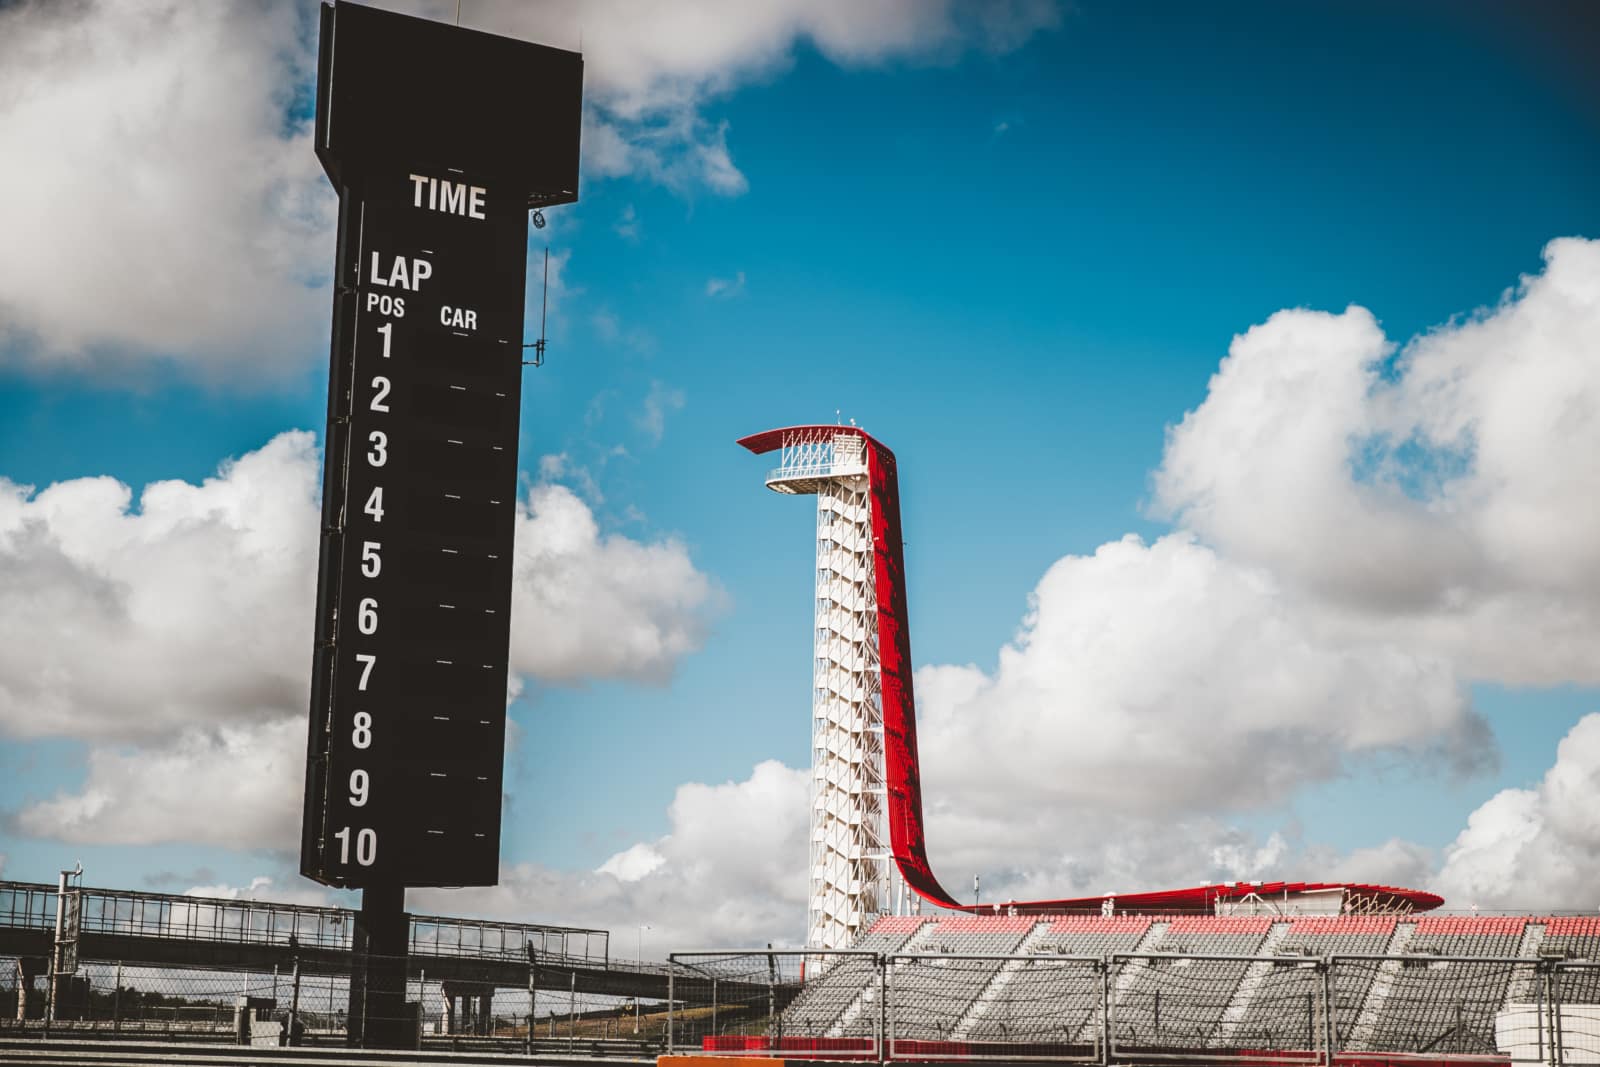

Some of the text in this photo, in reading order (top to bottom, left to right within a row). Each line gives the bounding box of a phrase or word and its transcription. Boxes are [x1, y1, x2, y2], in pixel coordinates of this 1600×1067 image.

[409, 173, 486, 220] TIME
[370, 251, 433, 292] LAP
[366, 292, 477, 331] POS CAR
[376, 322, 392, 358] 1
[370, 375, 391, 413] 2
[367, 430, 388, 467] 3
[364, 486, 385, 523] 4
[361, 540, 382, 578] 5
[358, 597, 378, 635] 6
[355, 653, 377, 691] 7
[351, 711, 372, 749] 8
[348, 768, 370, 807] 9
[334, 826, 377, 866] 10
